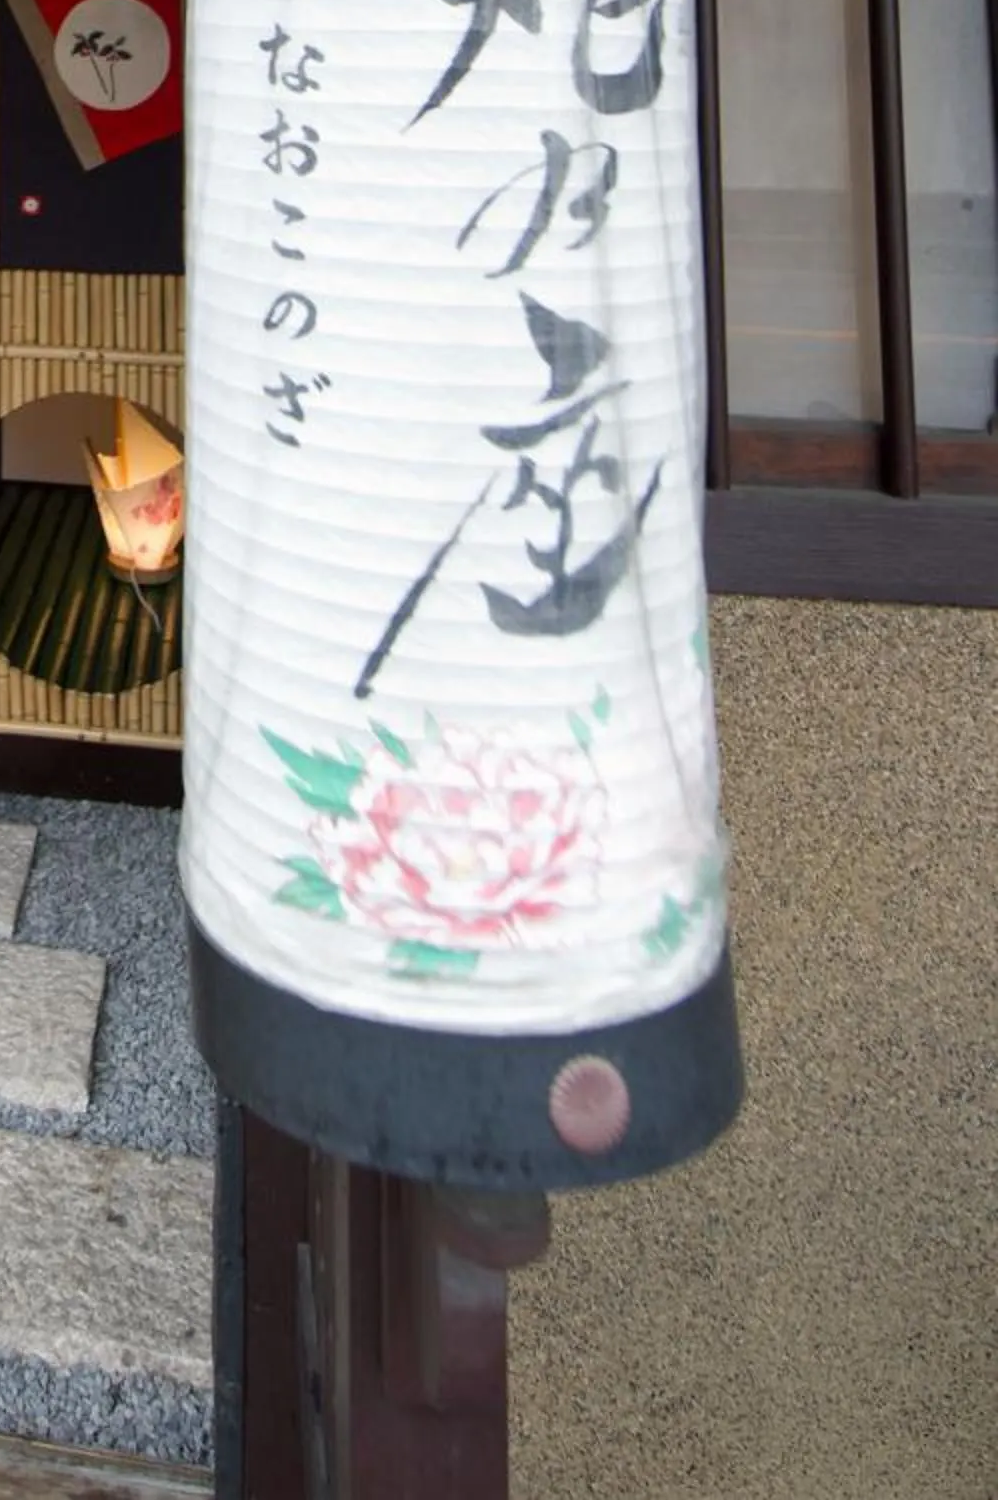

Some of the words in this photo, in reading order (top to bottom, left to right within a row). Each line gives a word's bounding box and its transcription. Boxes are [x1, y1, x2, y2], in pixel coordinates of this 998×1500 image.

[259, 23, 332, 449] なおこのざ
